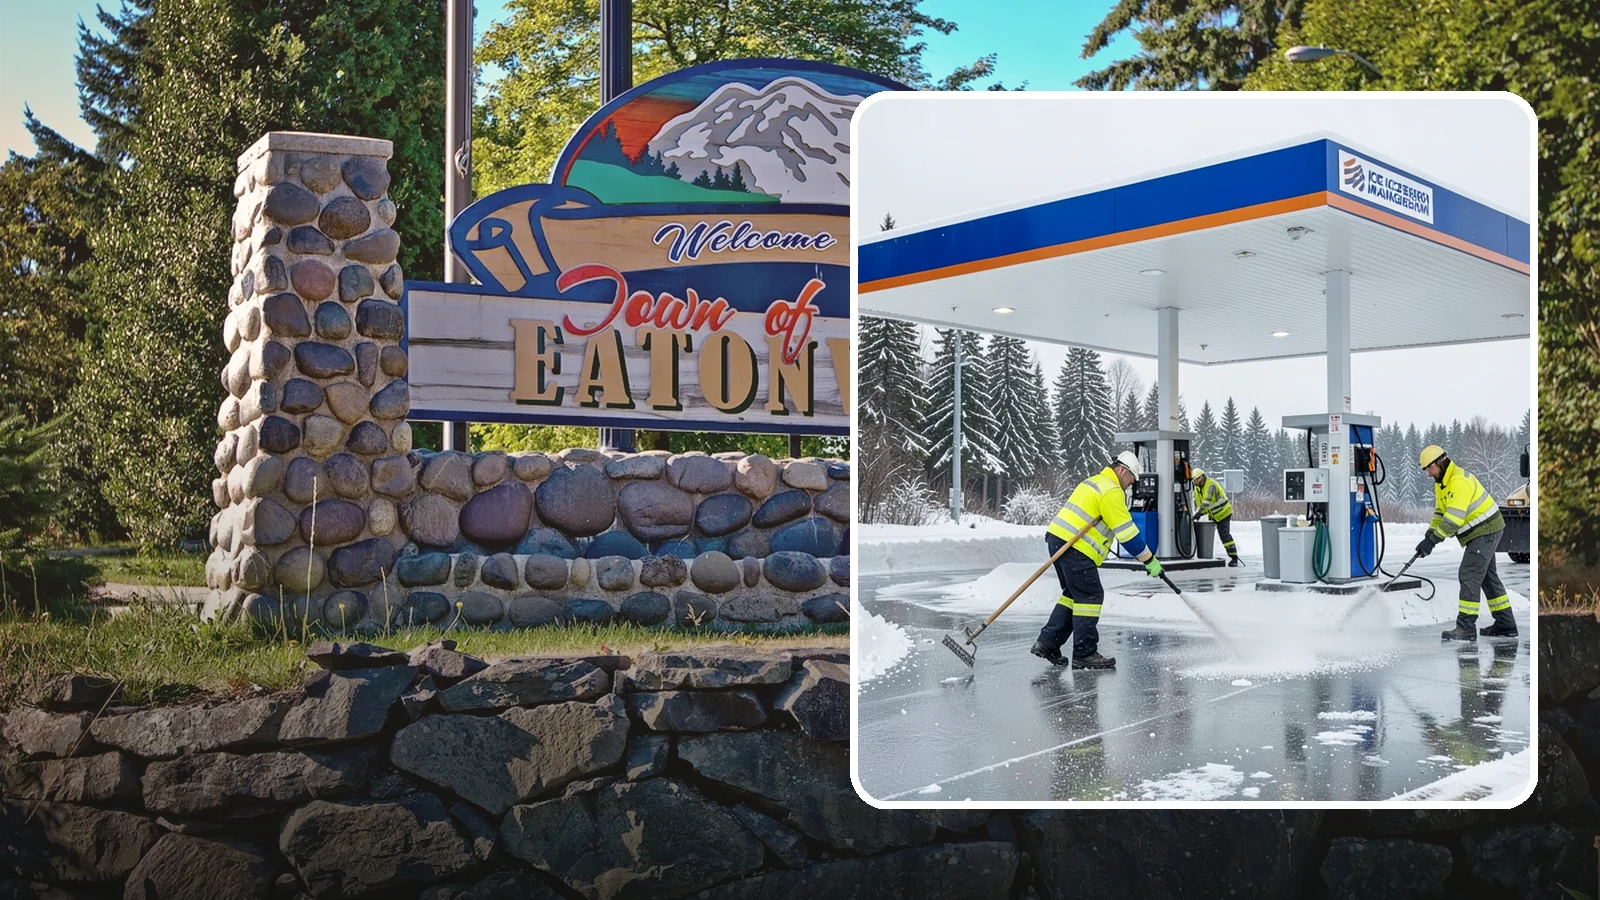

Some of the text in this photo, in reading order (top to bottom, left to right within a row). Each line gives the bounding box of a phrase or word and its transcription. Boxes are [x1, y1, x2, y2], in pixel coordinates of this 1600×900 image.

[653, 220, 837, 263] Welcome
[557, 263, 826, 365] Town of
